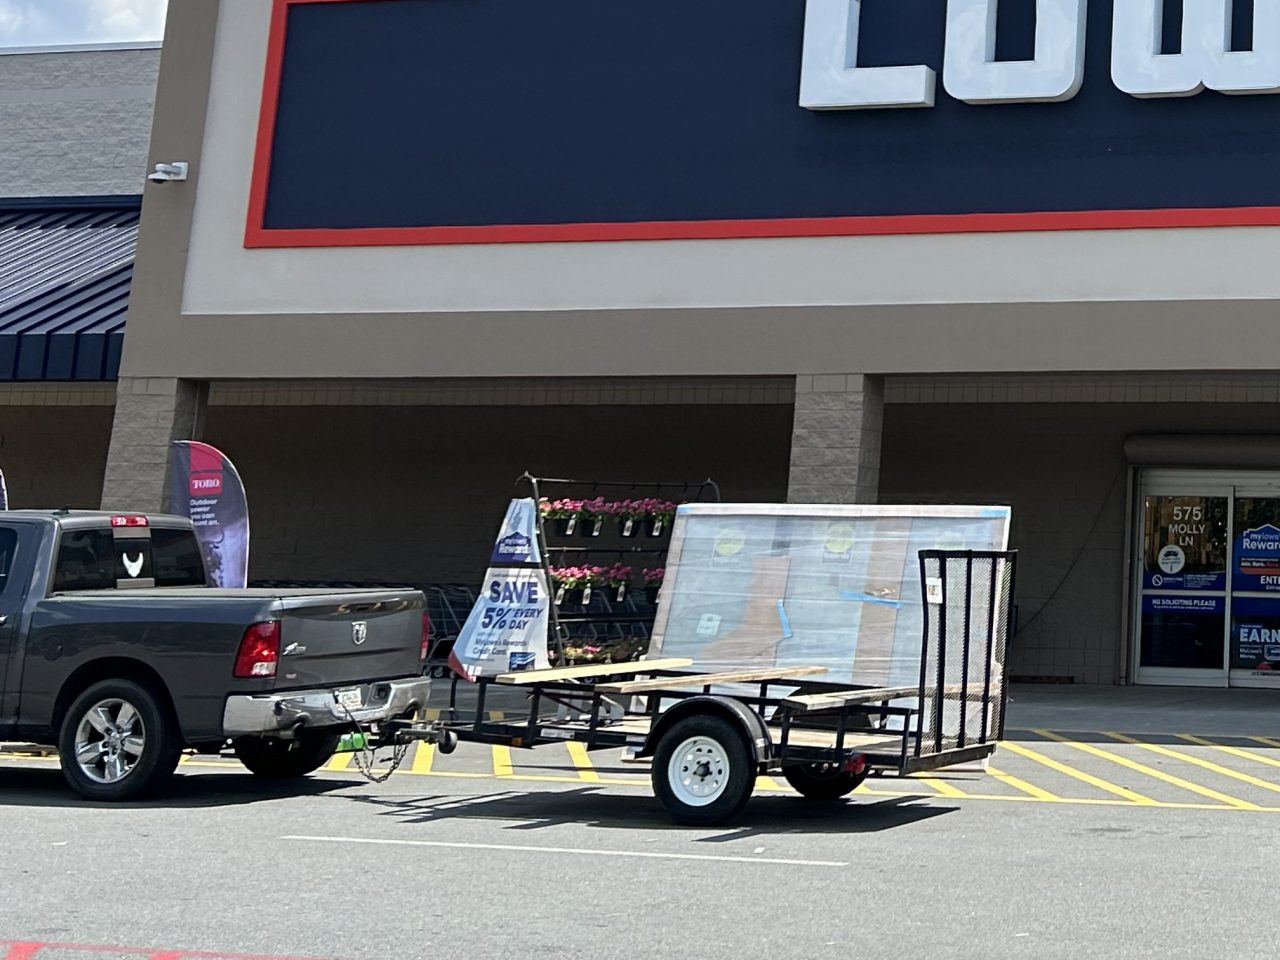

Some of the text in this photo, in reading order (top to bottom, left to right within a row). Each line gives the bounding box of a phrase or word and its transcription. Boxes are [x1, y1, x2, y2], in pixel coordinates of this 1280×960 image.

[192, 479, 220, 489] TORO
[1173, 506, 1202, 520] 575
[1168, 524, 1206, 534] MOLLY
[1179, 536, 1194, 546] LN
[489, 580, 539, 604] SAVE
[1193, 600, 1216, 608] PLEASE
[512, 608, 543, 618] EVERY
[508, 620, 529, 629] DAY
